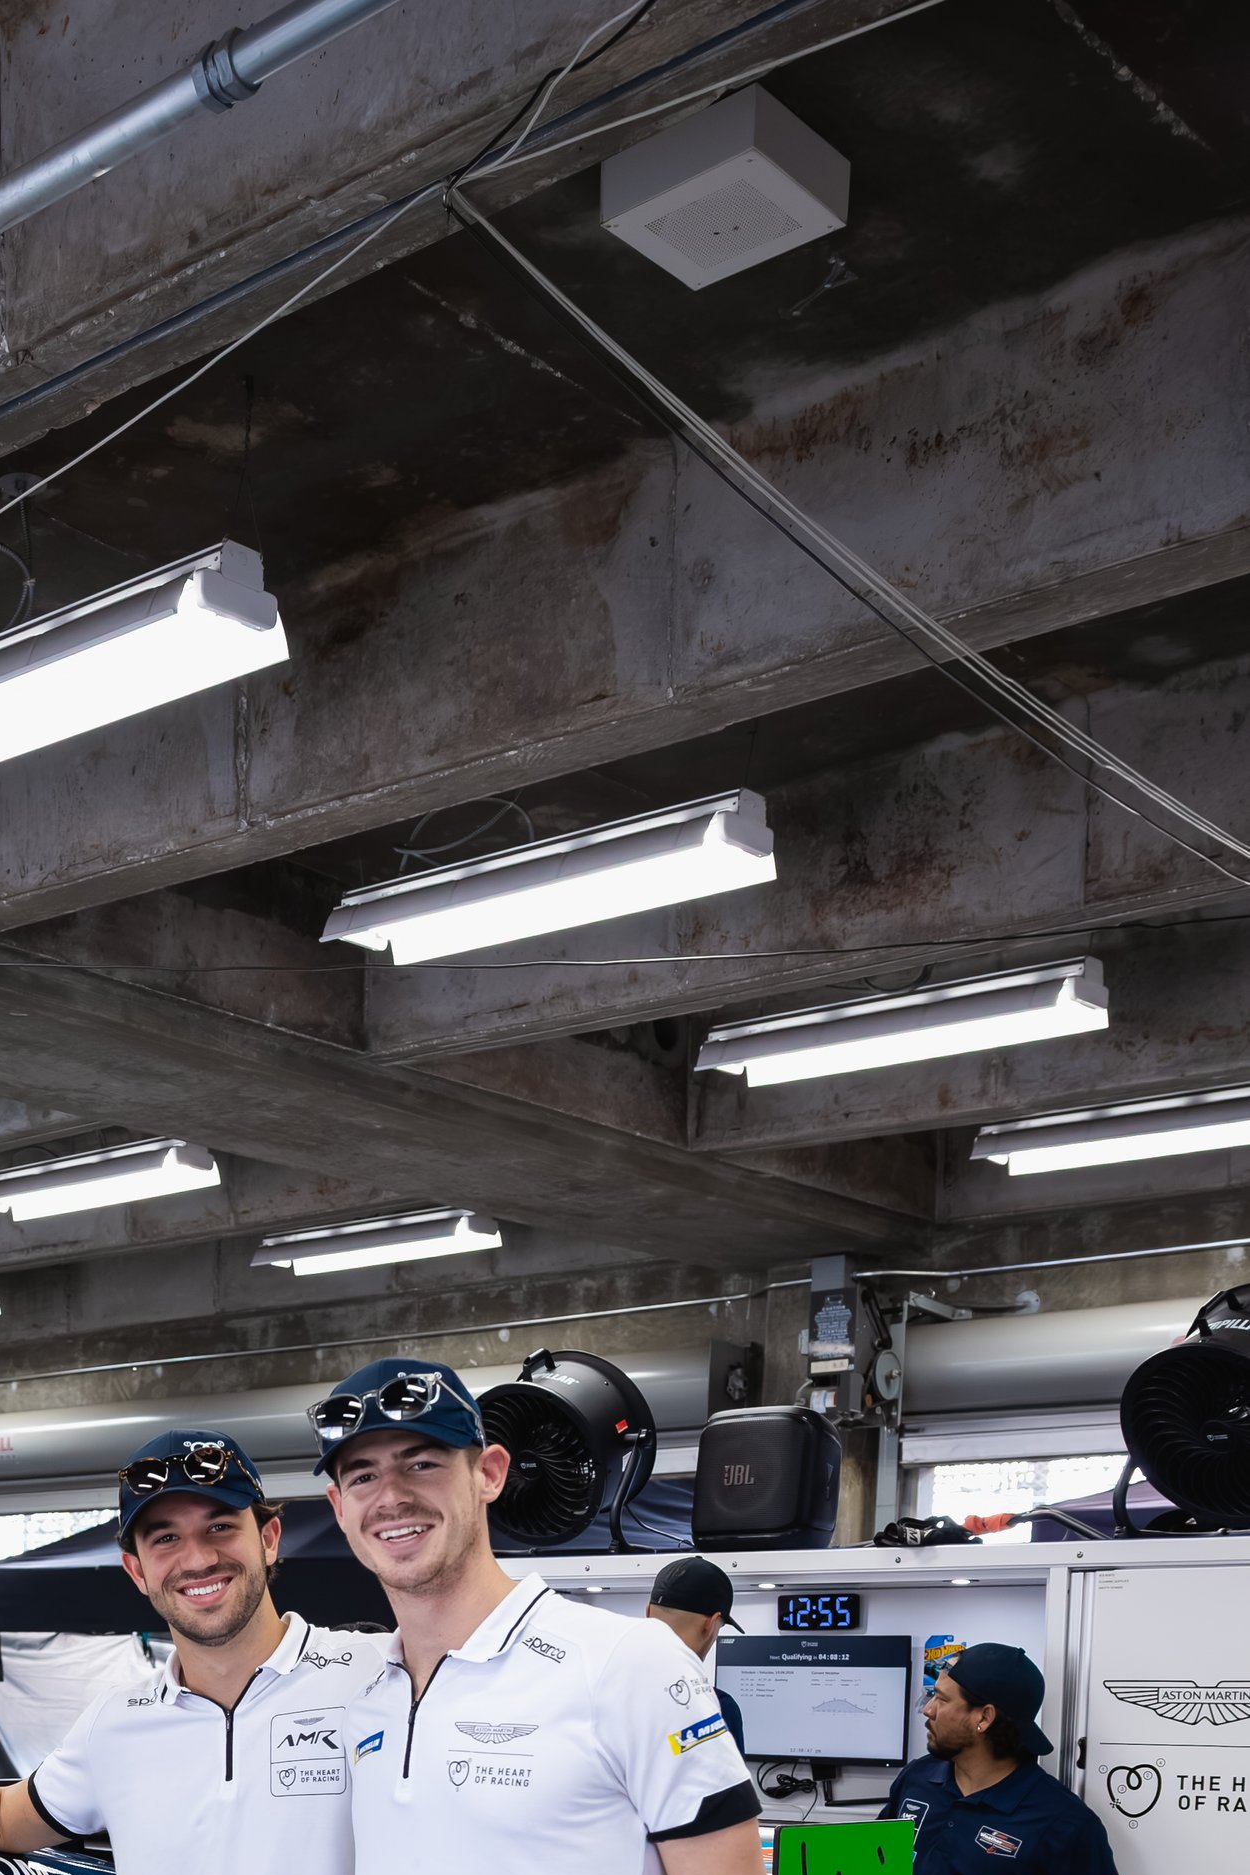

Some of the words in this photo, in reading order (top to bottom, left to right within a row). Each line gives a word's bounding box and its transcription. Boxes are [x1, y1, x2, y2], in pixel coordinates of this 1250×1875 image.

[724, 1464, 754, 1486] JBL
[789, 1597, 850, 1627] 12:55
[781, 1653, 812, 1662] Qualifying
[1161, 1690, 1201, 1700] ASTON
[1204, 1690, 1250, 1700] MARTIN
[277, 1729, 339, 1749] AMR
[475, 1766, 493, 1775] THE
[498, 1767, 532, 1778] HEART
[474, 1775, 486, 1784] OF
[490, 1777, 530, 1787] RACING
[1176, 1775, 1221, 1791] THE
[1178, 1795, 1206, 1811] OF
